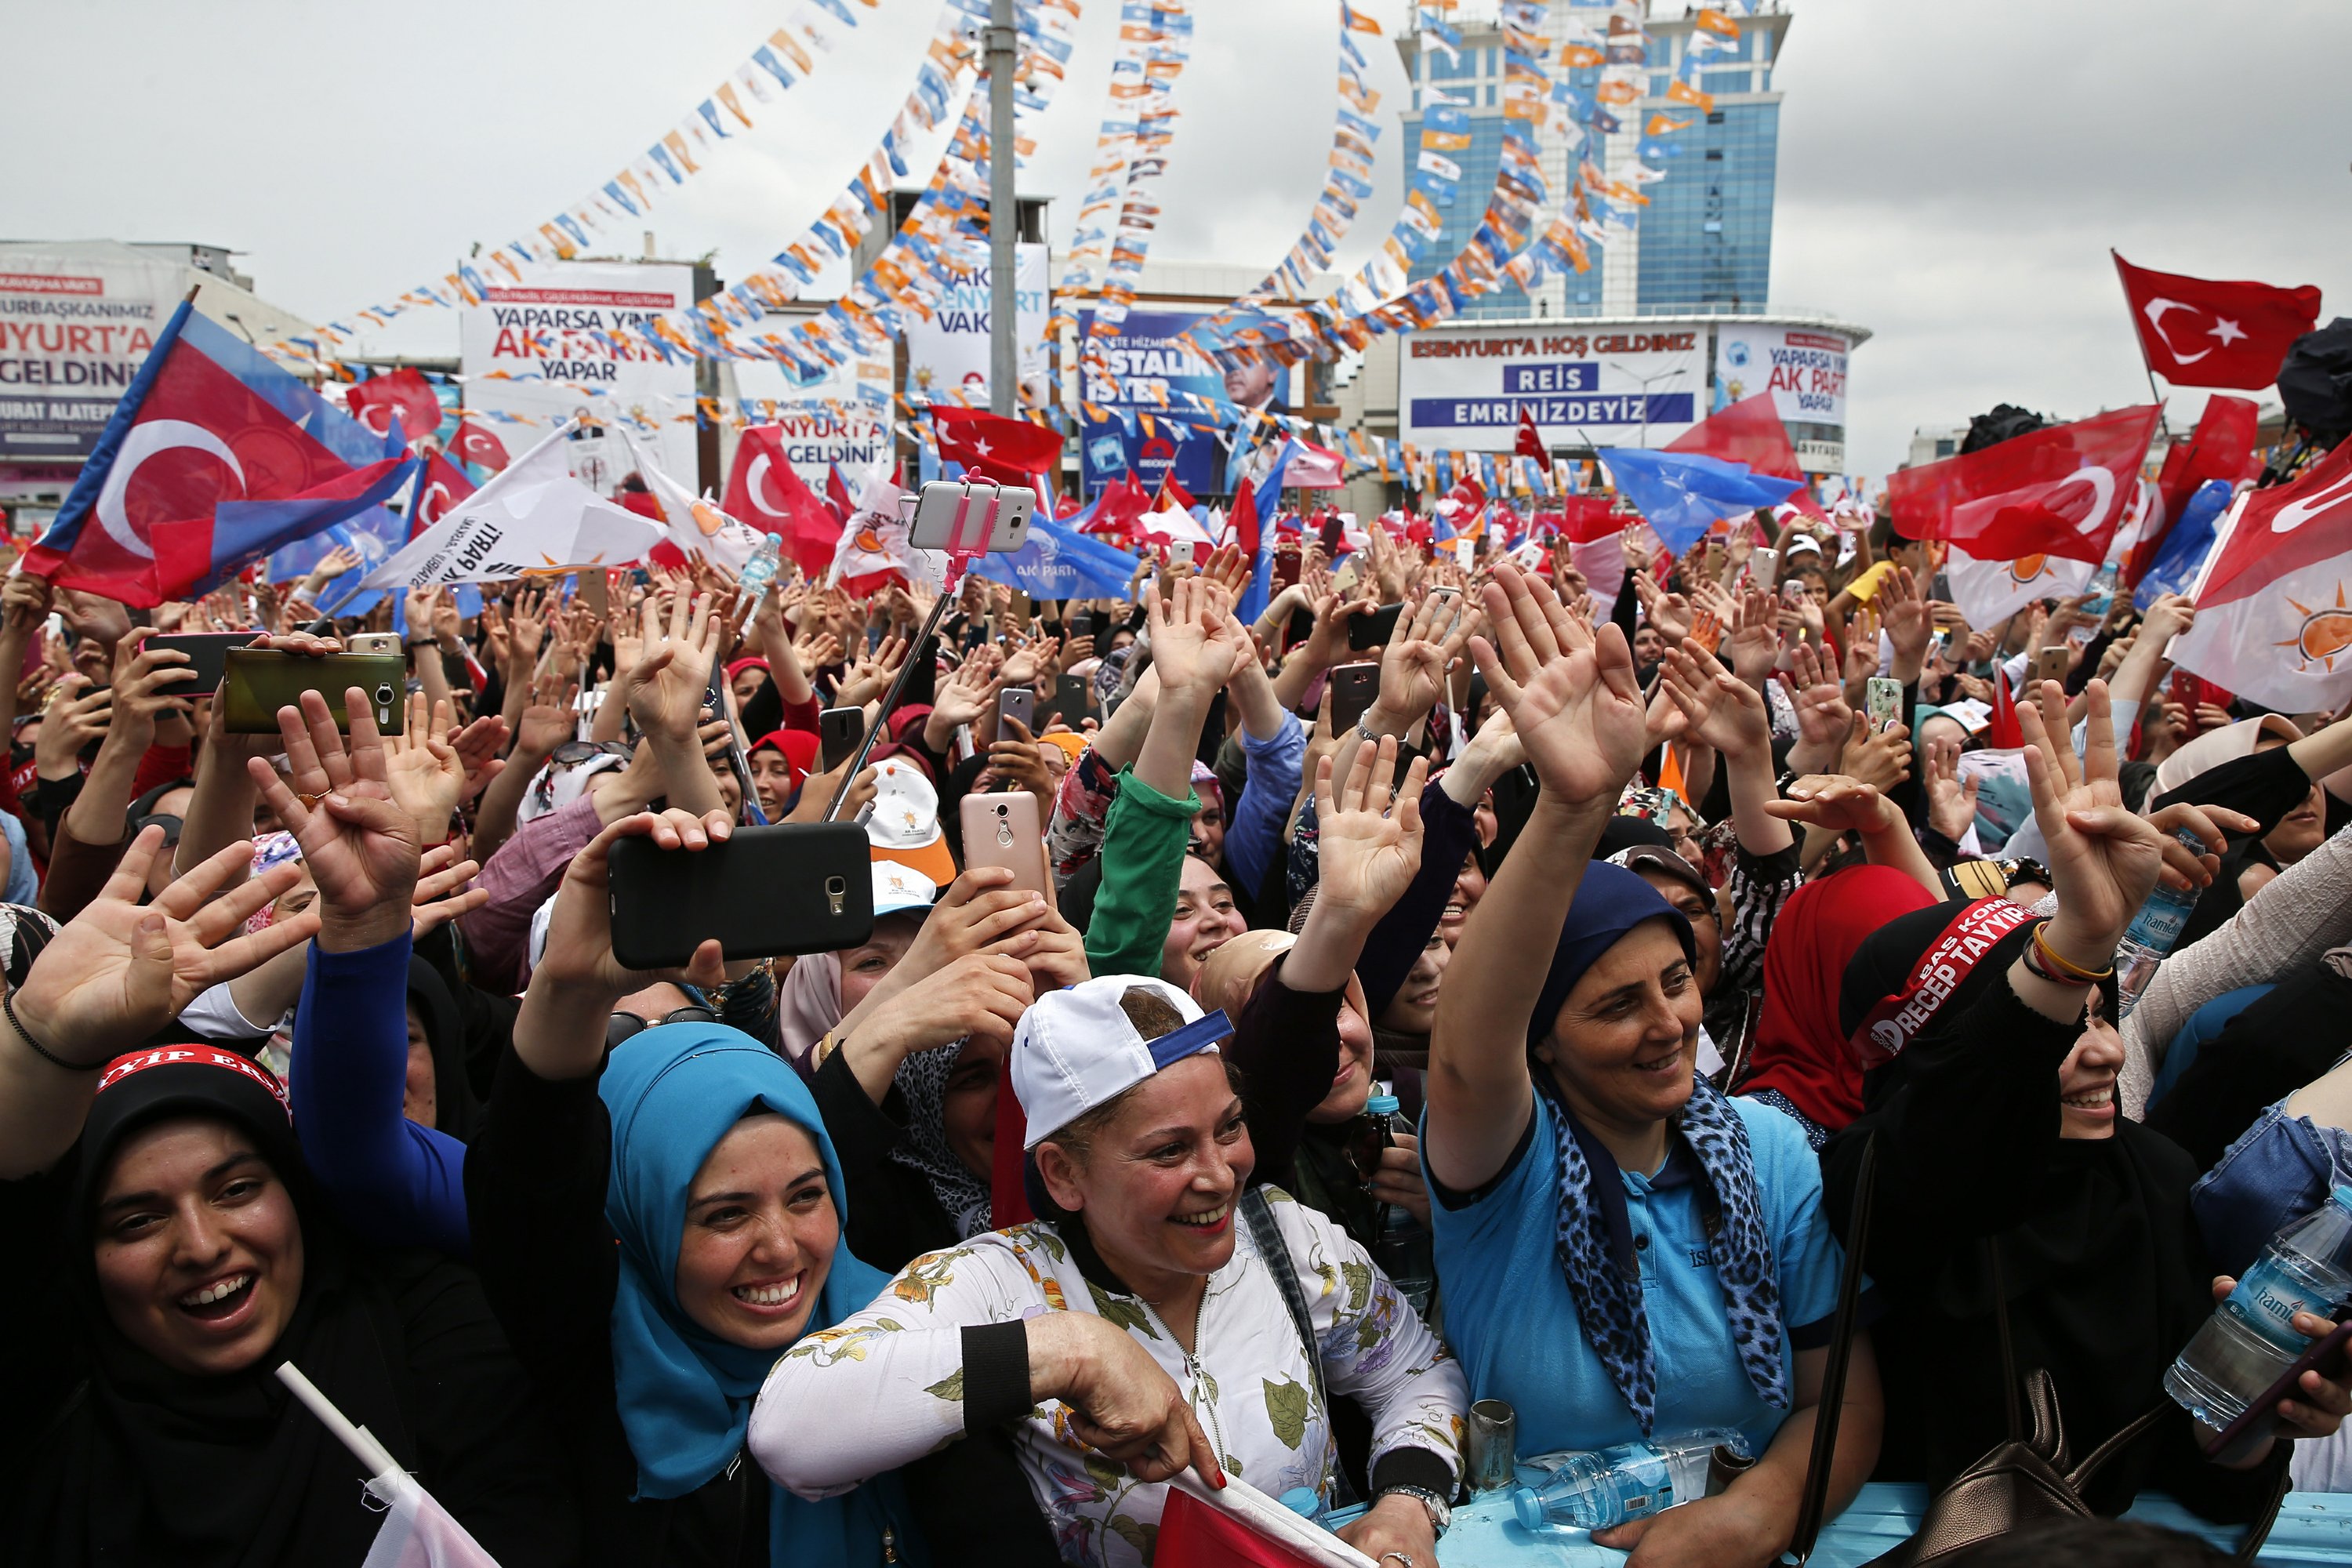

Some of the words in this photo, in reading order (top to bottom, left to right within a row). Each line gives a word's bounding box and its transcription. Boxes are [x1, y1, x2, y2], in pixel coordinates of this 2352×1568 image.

[0, 299, 154, 321] URBAŞKANIMIZ
[492, 307, 604, 330] YAPARSA
[1411, 338, 1537, 359] ESENYURT'A
[1541, 335, 1589, 359] HOŞ
[0, 359, 143, 387] GELDİNİ
[540, 361, 617, 382] YAPAR
[1518, 364, 1582, 391] REİS
[1767, 365, 1804, 393] AK
[1454, 395, 1645, 424] EMRİNİZDEYİZ
[1016, 564, 1037, 577] AK
[1894, 964, 1957, 1035] RECEP
[1948, 906, 2026, 966] TAYYİP
[2254, 1286, 2296, 1324] hami
